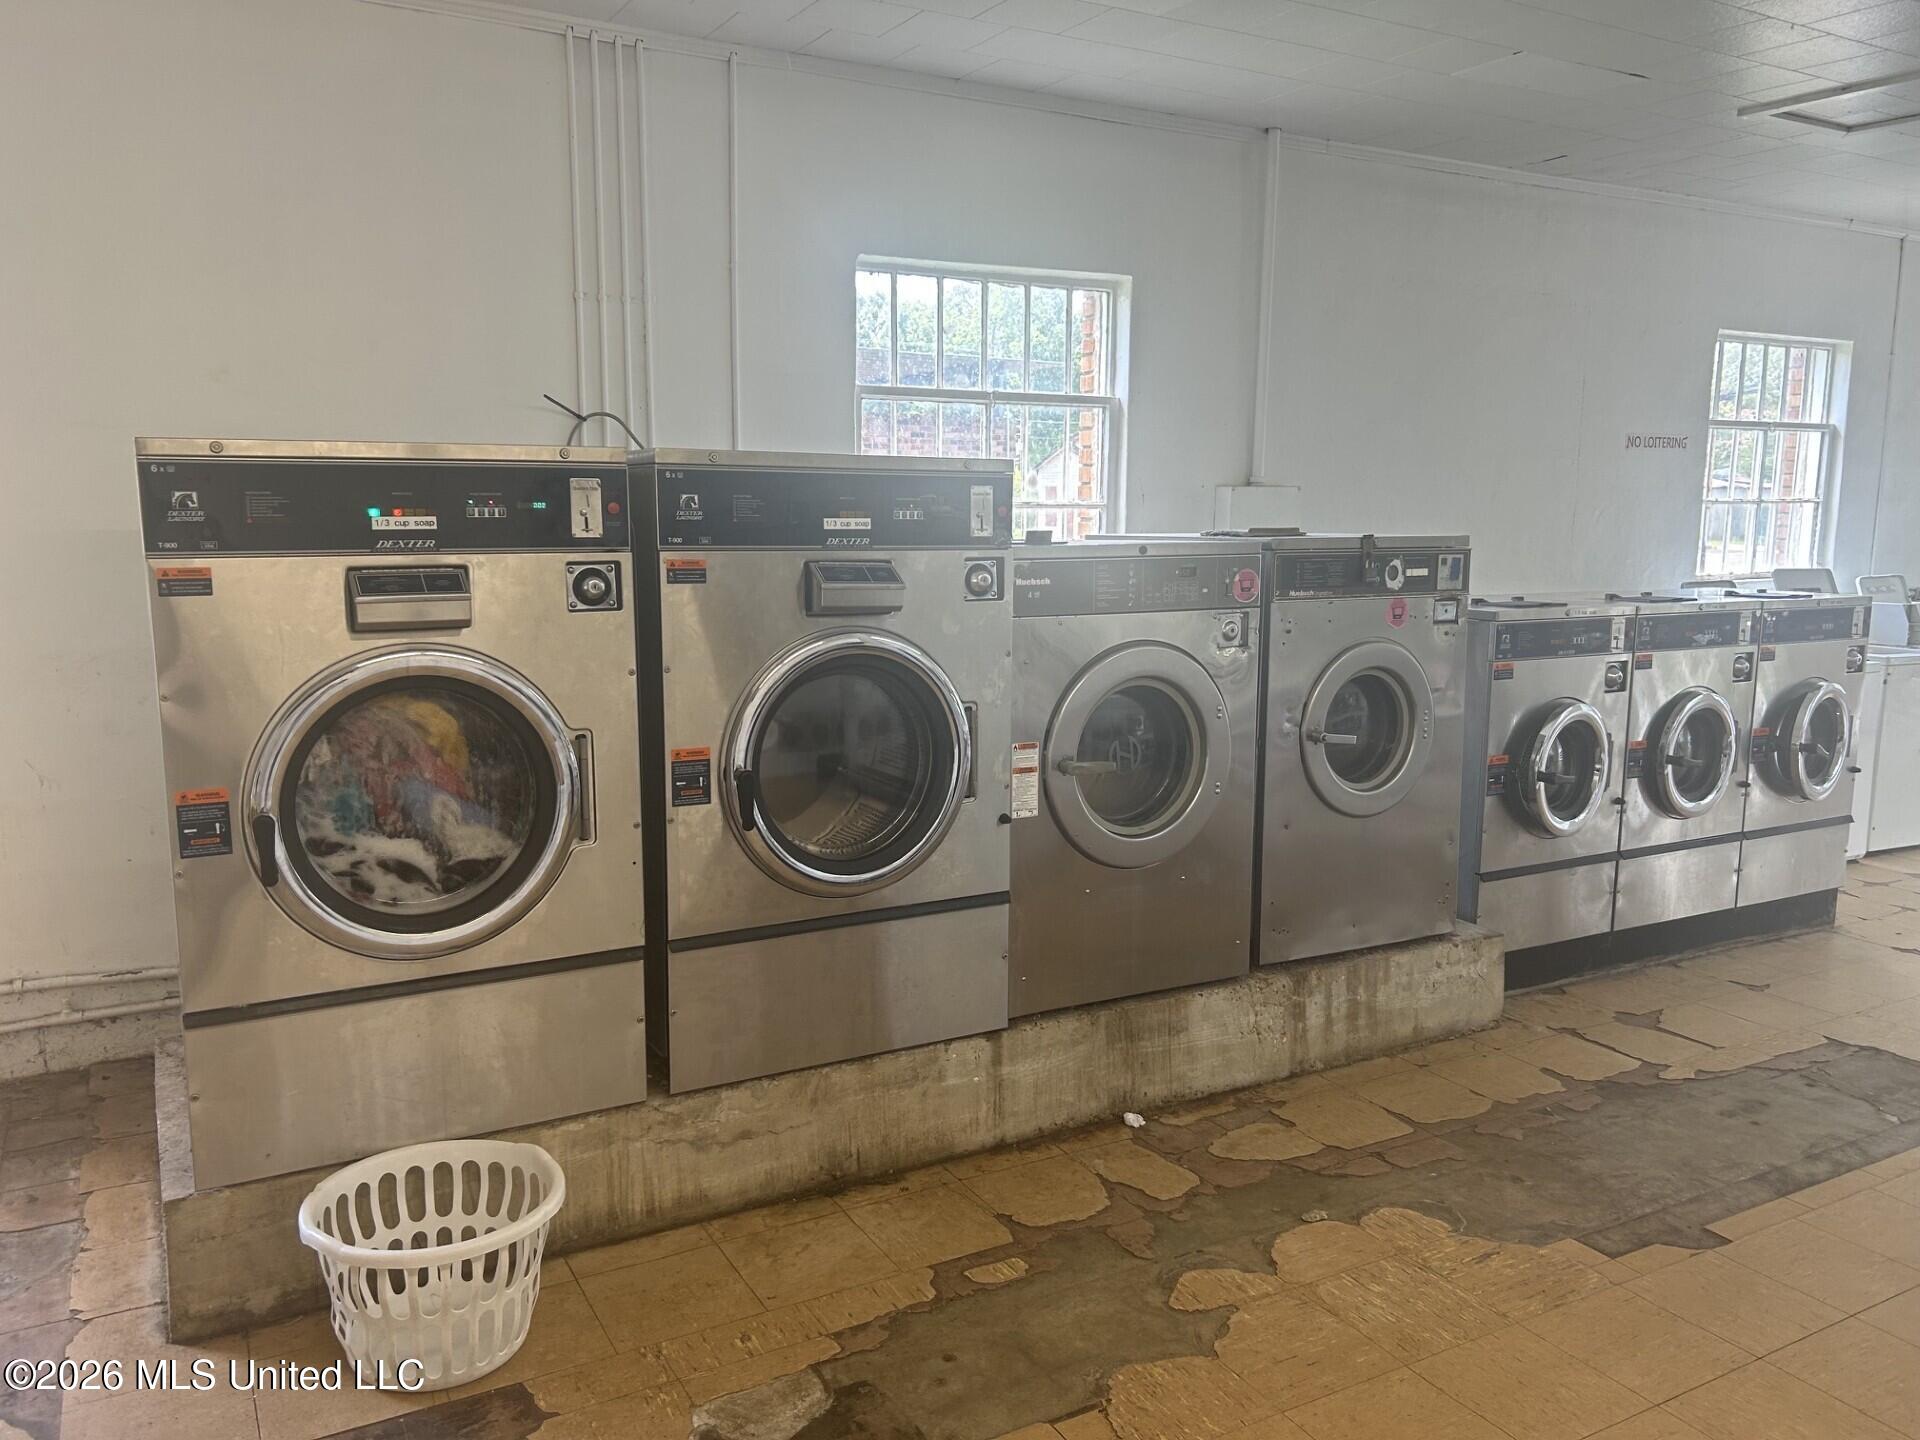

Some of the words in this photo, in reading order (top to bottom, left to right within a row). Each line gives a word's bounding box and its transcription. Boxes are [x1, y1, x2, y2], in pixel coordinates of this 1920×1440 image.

[1626, 435, 1641, 449] NO
[1643, 435, 1689, 449] LOITERING
[150, 464, 158, 473] 6
[375, 519, 390, 527] 1/3
[394, 520, 410, 528] cup
[414, 520, 435, 528] soap
[825, 520, 837, 528] 1/3
[376, 539, 436, 548] DEXTER
[826, 537, 870, 545] DEXTER
